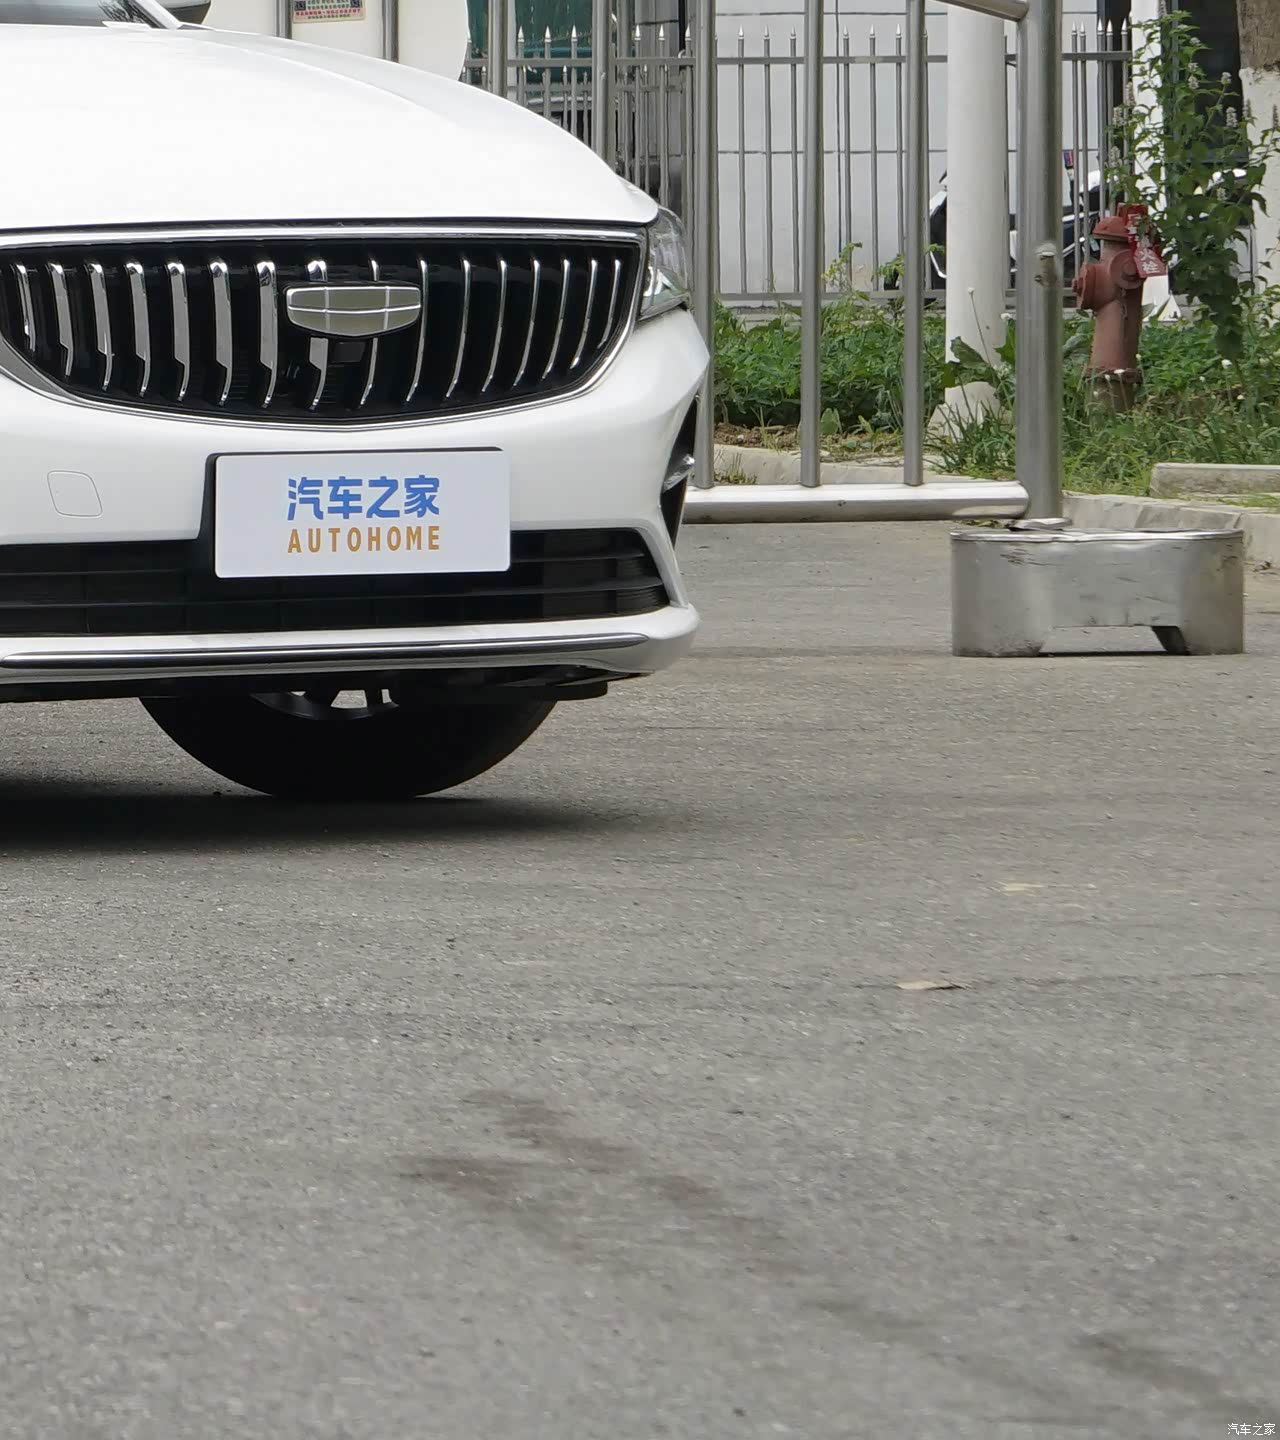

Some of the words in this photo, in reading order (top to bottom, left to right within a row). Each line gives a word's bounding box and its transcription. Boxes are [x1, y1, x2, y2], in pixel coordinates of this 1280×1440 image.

[287, 474, 440, 521] 汽车之家
[287, 525, 441, 554] AUTOHOME
